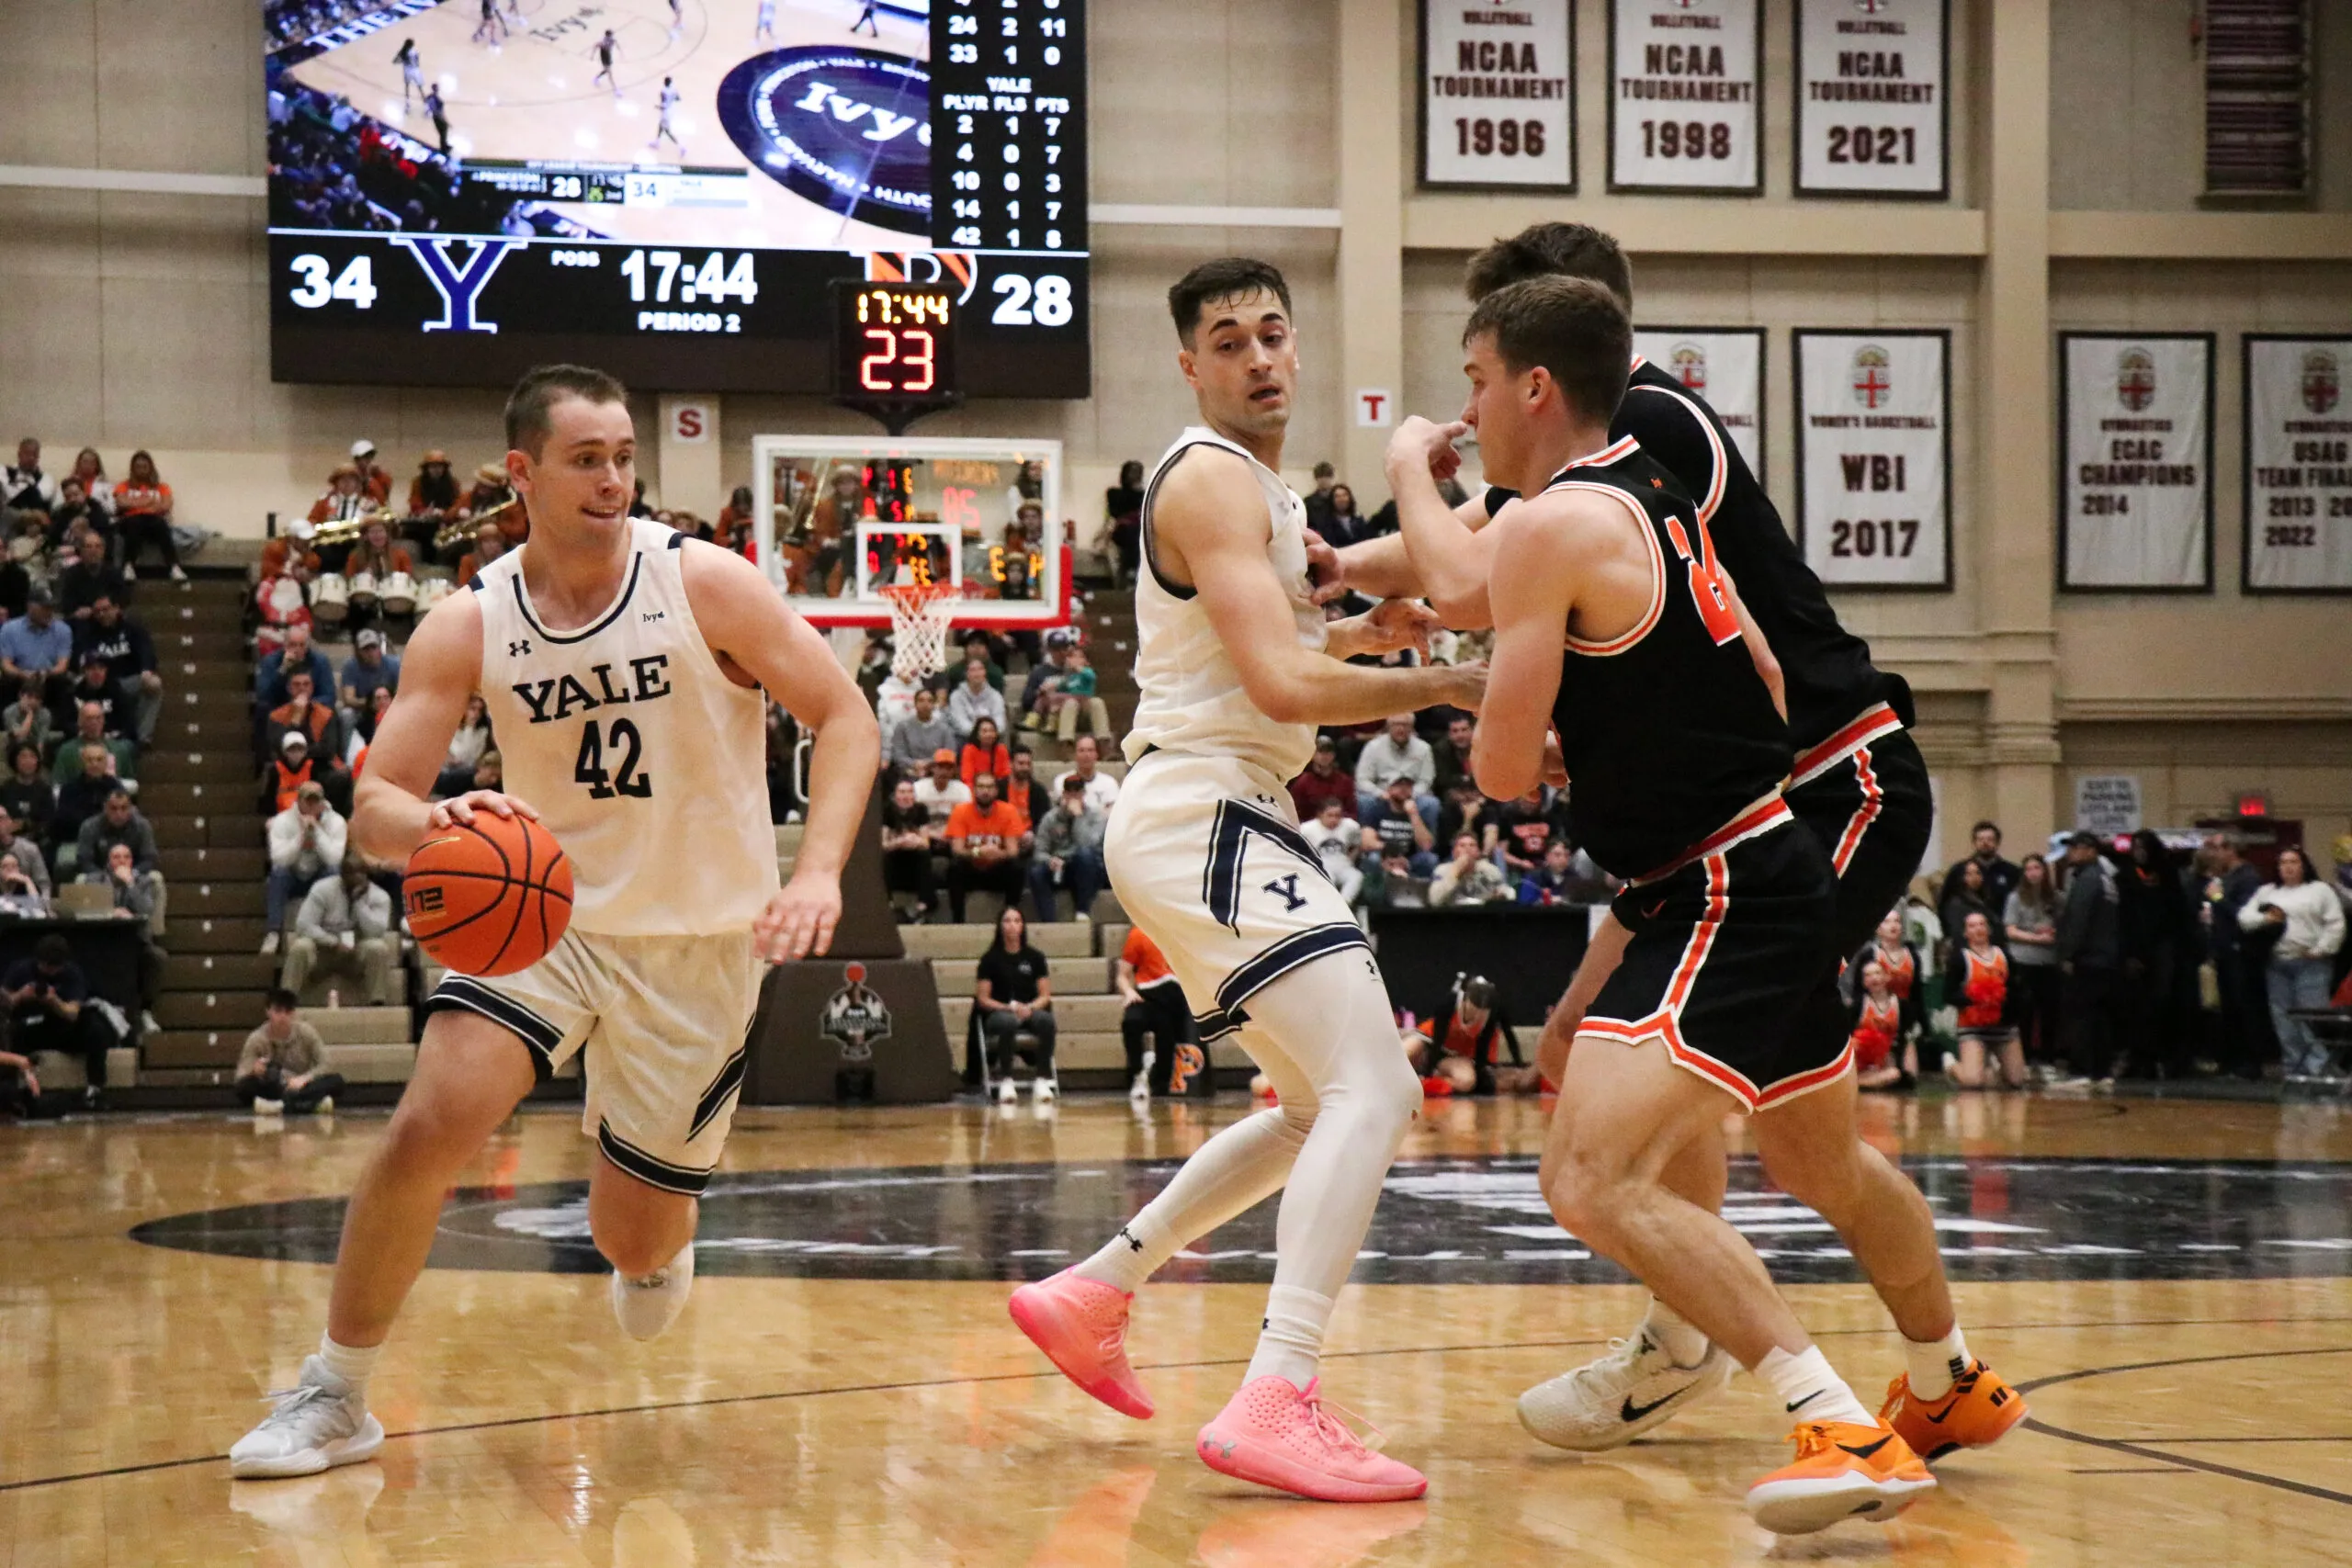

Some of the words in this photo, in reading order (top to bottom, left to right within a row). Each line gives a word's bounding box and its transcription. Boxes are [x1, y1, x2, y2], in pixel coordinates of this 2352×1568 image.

[948, 15, 978, 36] 24
[1001, 17, 1018, 37] 2
[1039, 17, 1066, 38] 11
[948, 43, 978, 64] 33
[1003, 45, 1017, 65] 1
[1044, 46, 1060, 66] 0
[1457, 40, 1538, 73] NCAA
[1645, 44, 1724, 76] NCAA
[1838, 51, 1904, 77] NCAA
[985, 76, 1033, 94] YALE
[1433, 76, 1565, 100] TOURNAMENT
[1621, 77, 1751, 103] TOURNAMENT
[1809, 81, 1934, 104] TOURNAMENT
[794, 81, 917, 141] Ivy
[942, 94, 989, 111] PLYR
[993, 96, 1028, 112] FLS
[1035, 96, 1070, 114] PTS
[957, 114, 974, 133] 2
[1005, 116, 1019, 135] 1
[1045, 117, 1061, 136] 7
[1455, 117, 1545, 157] 1996
[956, 142, 974, 163] 4
[1002, 143, 1020, 164] 0
[1045, 145, 1061, 164] 7
[1641, 120, 1731, 160] 1998
[1827, 125, 1916, 164] 2021
[552, 175, 582, 198] 28
[951, 170, 980, 190] 10
[1003, 172, 1020, 192] 0
[1045, 173, 1061, 193] 3
[951, 198, 981, 219] 14
[1006, 200, 1020, 220] 1
[1045, 201, 1062, 220] 7
[951, 226, 981, 246] 42
[1007, 228, 1020, 248] 1
[1046, 229, 1062, 249] 8
[289, 254, 377, 310] 34
[621, 249, 758, 305] 17:44
[857, 289, 949, 325] 17:44
[991, 274, 1073, 326] 28
[638, 310, 722, 332] PERIOD
[725, 313, 741, 333] 2
[861, 329, 934, 391] 23
[1363, 394, 1385, 422] T
[677, 408, 703, 438] S
[1840, 455, 1906, 492] WBI
[1831, 519, 1920, 558] 2017
[643, 614, 657, 624] Ivy
[512, 654, 671, 724] YALE
[574, 717, 653, 799] 42
[1261, 872, 1309, 914] Y
